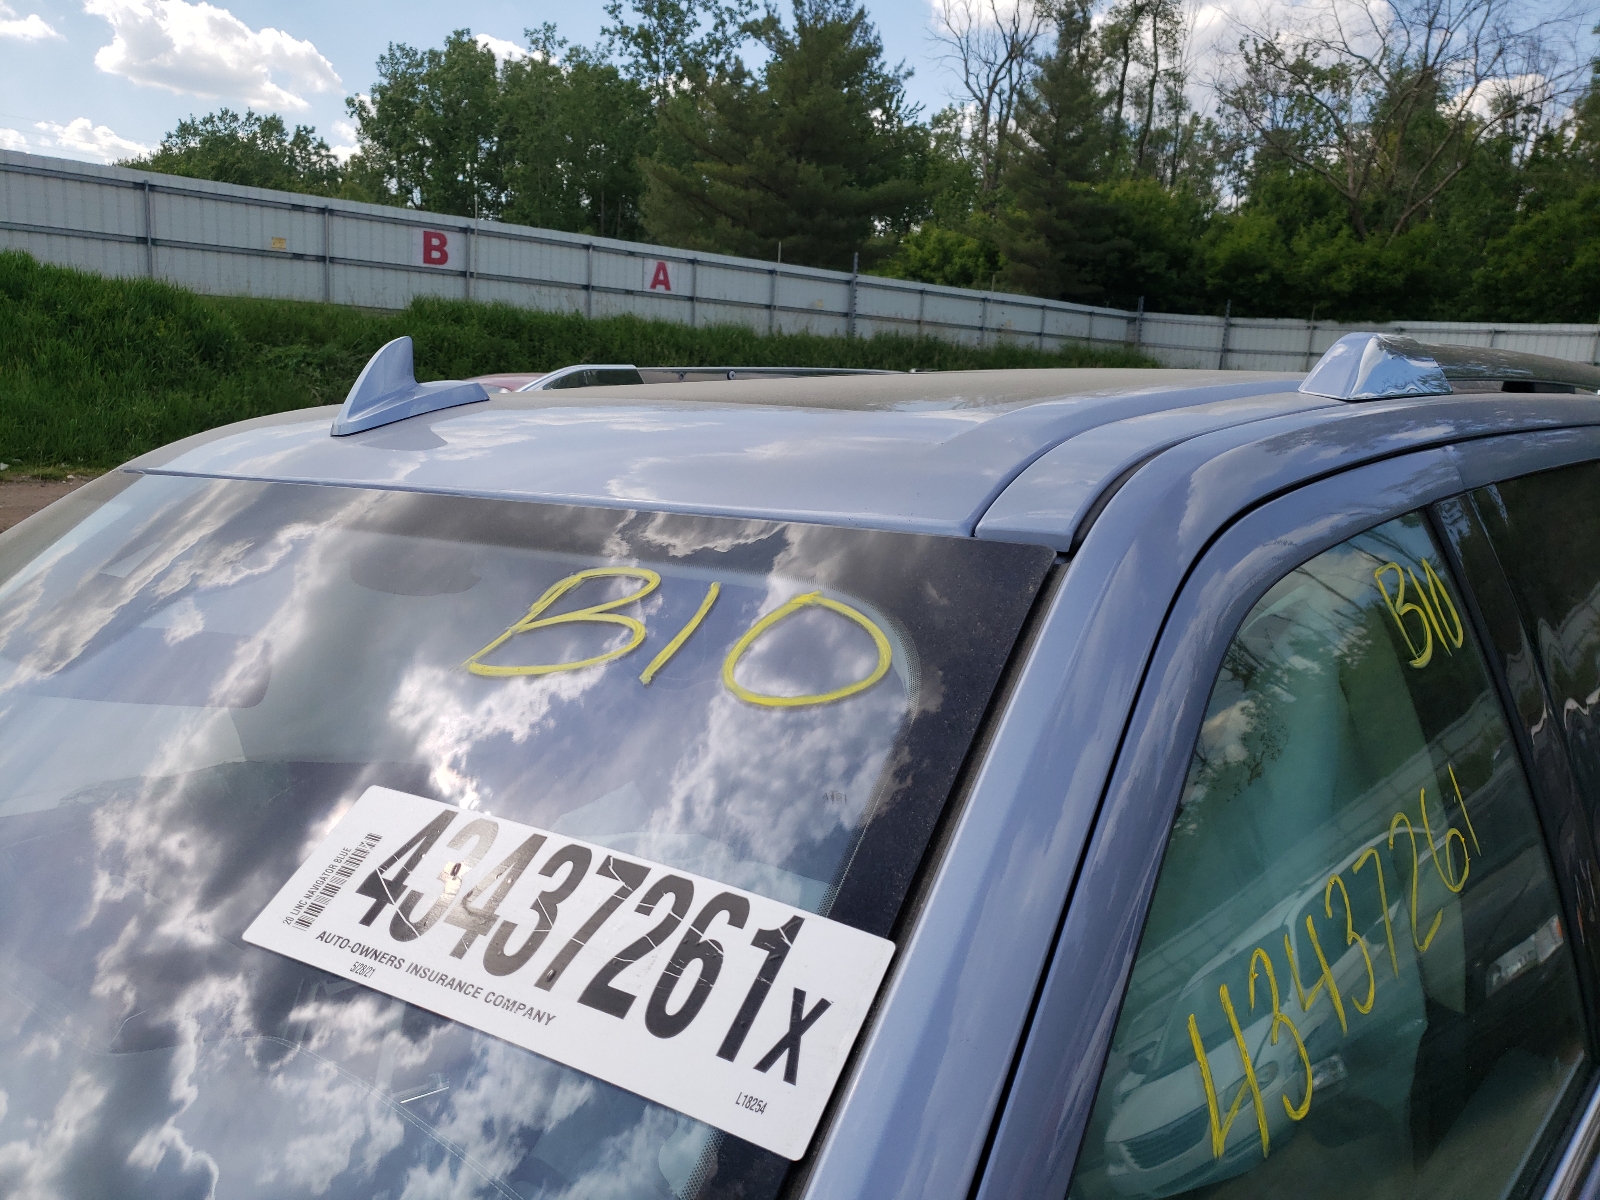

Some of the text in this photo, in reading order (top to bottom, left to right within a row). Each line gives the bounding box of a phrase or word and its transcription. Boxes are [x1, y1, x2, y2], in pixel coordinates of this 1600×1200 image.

[422, 230, 449, 266] B
[649, 261, 672, 292] A
[282, 846, 352, 925] 20 LINC NAVIGATOR BLUE
[315, 930, 557, 1027] AUTO-OWNERS INSURANCE COMPANY
[349, 961, 377, 979] 5/28/21
[1187, 762, 1482, 1161] 43437261
[735, 1091, 768, 1115] L18254
